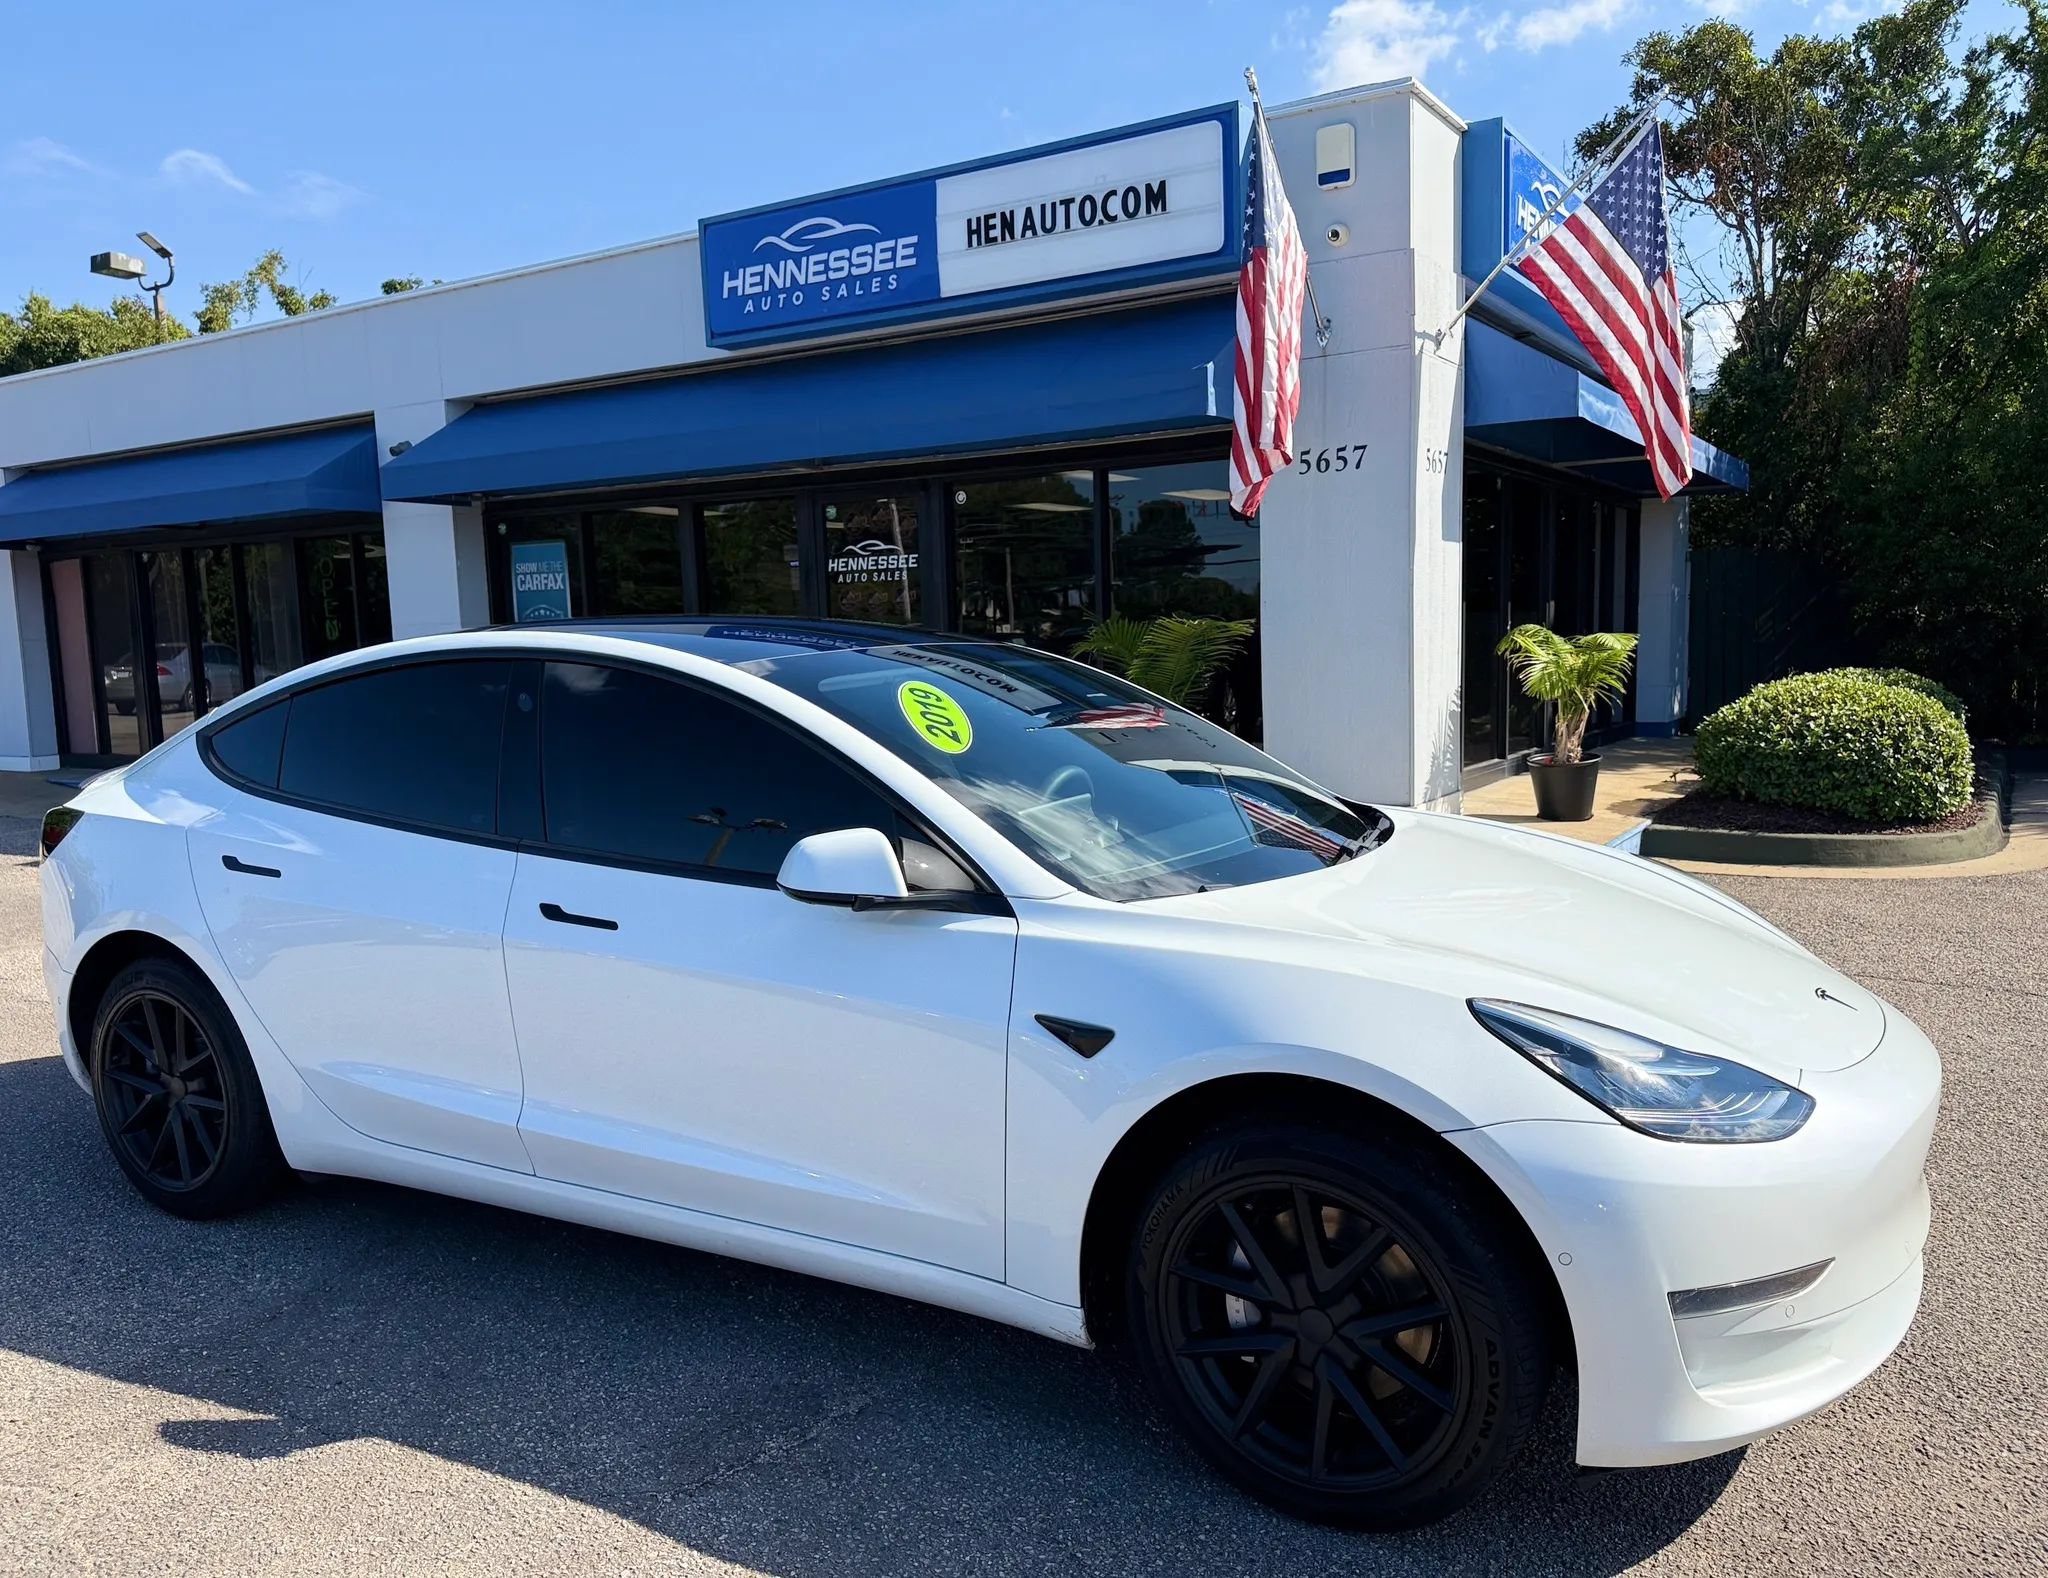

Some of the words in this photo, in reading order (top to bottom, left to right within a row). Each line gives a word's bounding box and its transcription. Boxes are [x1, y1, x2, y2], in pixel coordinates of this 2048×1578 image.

[966, 179, 1168, 249] HENAUTO.COM
[722, 235, 918, 299] HENNESSEE
[743, 291, 804, 314] AUTO
[821, 273, 899, 301] SALES
[1298, 444, 1368, 475] 5657
[1425, 447, 1449, 475] 5657
[515, 561, 538, 574] SHOW
[516, 573, 565, 592] CARFAX
[827, 553, 919, 573] HENNESSEE
[837, 572, 868, 584] AUTO
[873, 570, 908, 582] SALES
[319, 557, 340, 641] OPEN
[907, 687, 962, 746] 2019
[1141, 1183, 1185, 1249] YOKOHAMA
[1477, 1336, 1501, 1441] ADVAN
